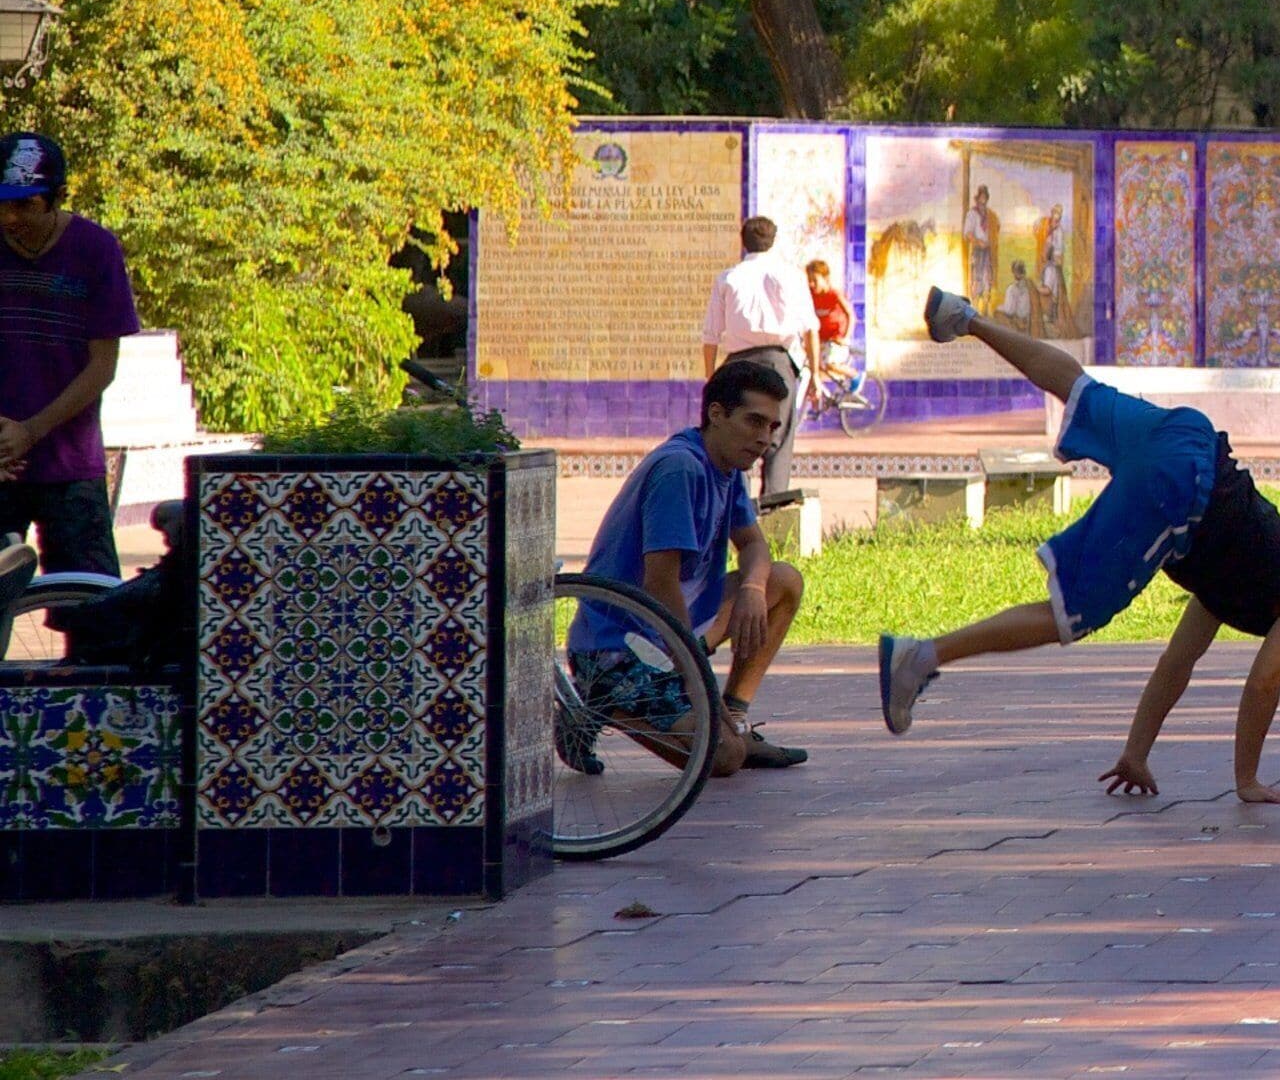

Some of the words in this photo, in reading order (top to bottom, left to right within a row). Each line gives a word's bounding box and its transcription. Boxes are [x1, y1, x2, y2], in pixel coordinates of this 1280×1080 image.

[651, 185, 663, 197] LA
[666, 185, 685, 197] LEY
[597, 199, 611, 210] LA
[614, 199, 652, 210] PLAZA
[657, 196, 704, 210] ESPAÑA
[590, 359, 628, 371] MARZO
